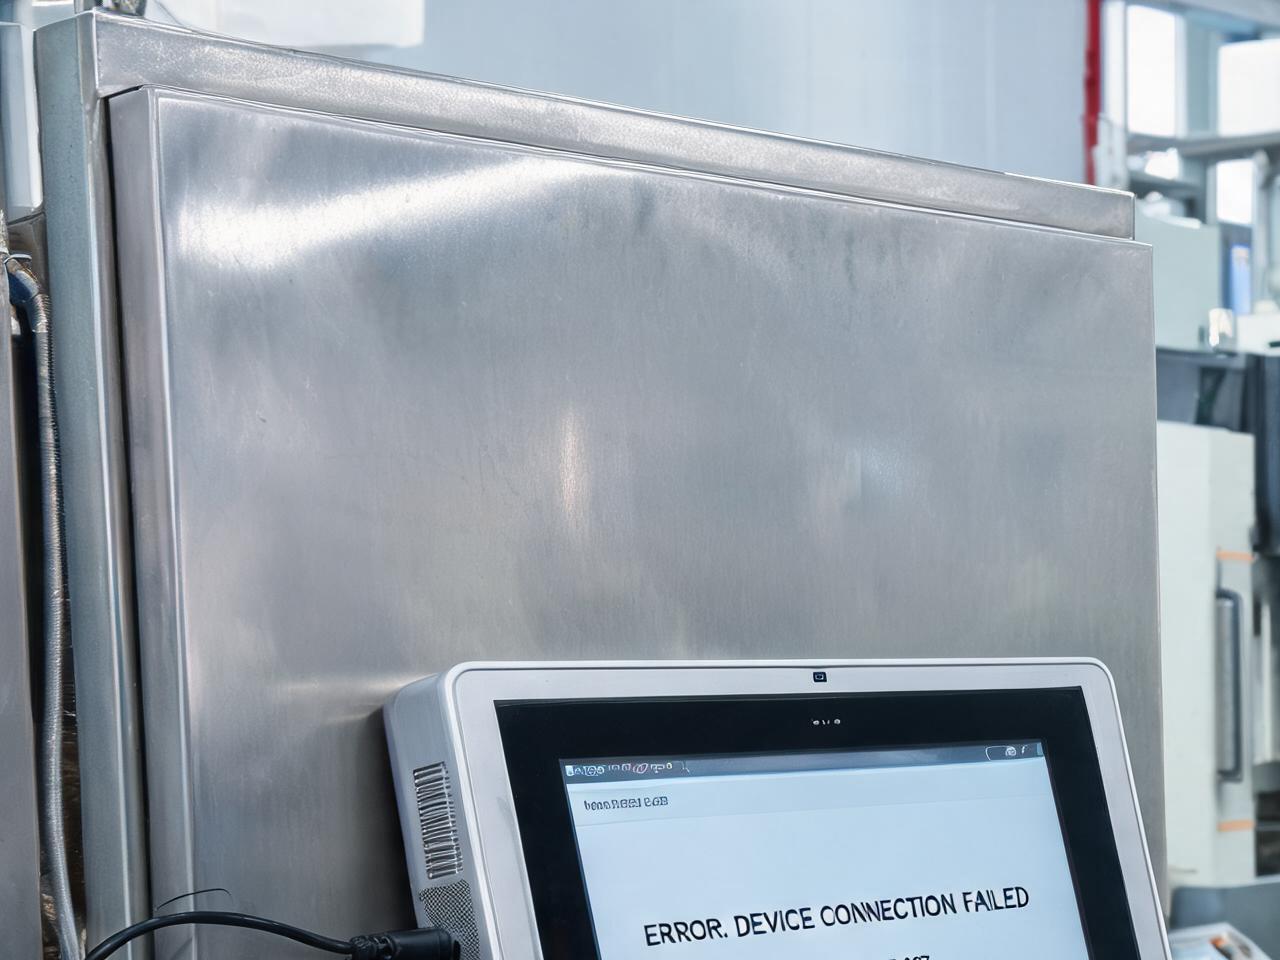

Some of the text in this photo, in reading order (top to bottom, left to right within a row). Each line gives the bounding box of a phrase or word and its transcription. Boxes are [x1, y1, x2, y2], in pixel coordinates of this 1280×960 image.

[734, 907, 815, 935] DEVICE
[820, 893, 957, 926] CONNECTION
[962, 886, 1029, 912] FAILED
